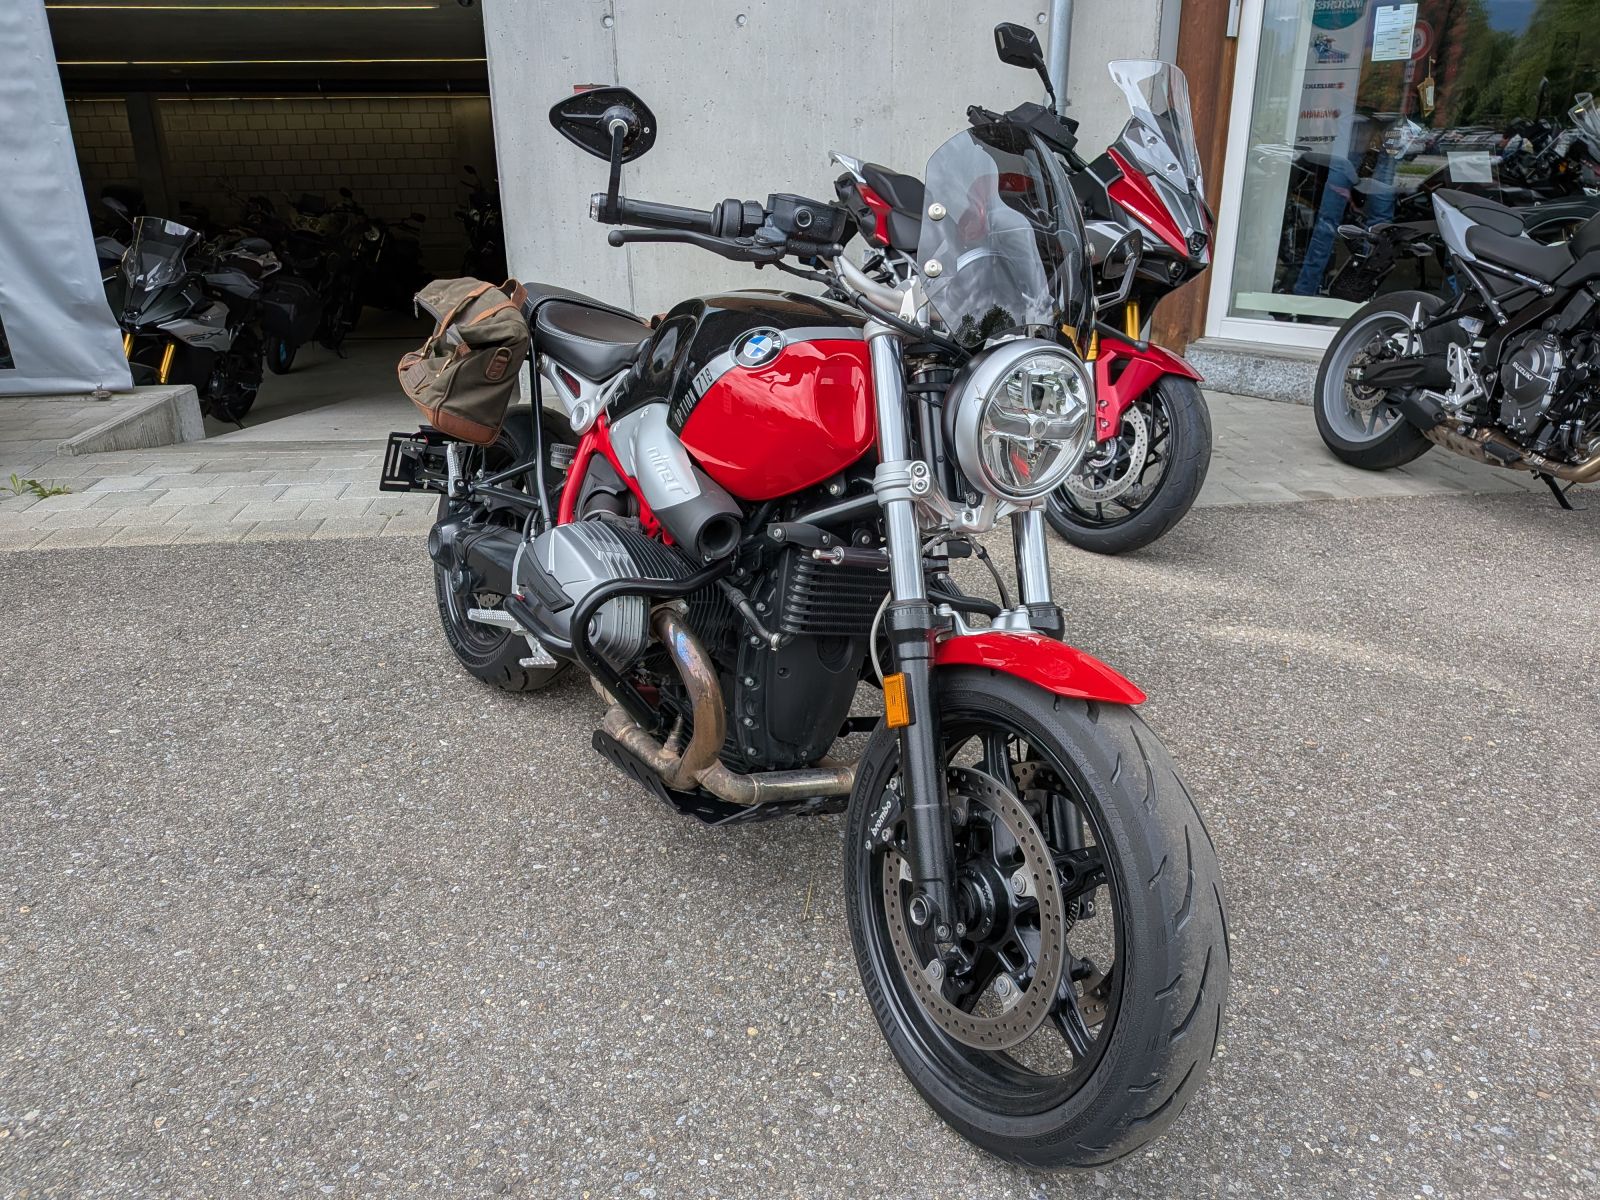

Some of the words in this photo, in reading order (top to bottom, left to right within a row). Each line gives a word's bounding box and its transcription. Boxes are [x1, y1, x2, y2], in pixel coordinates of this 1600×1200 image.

[1512, 361, 1534, 381] SUZUKI
[674, 388, 697, 428] OPTION
[694, 367, 713, 393] 719
[647, 446, 689, 495] nineT
[871, 800, 892, 837] brembo
